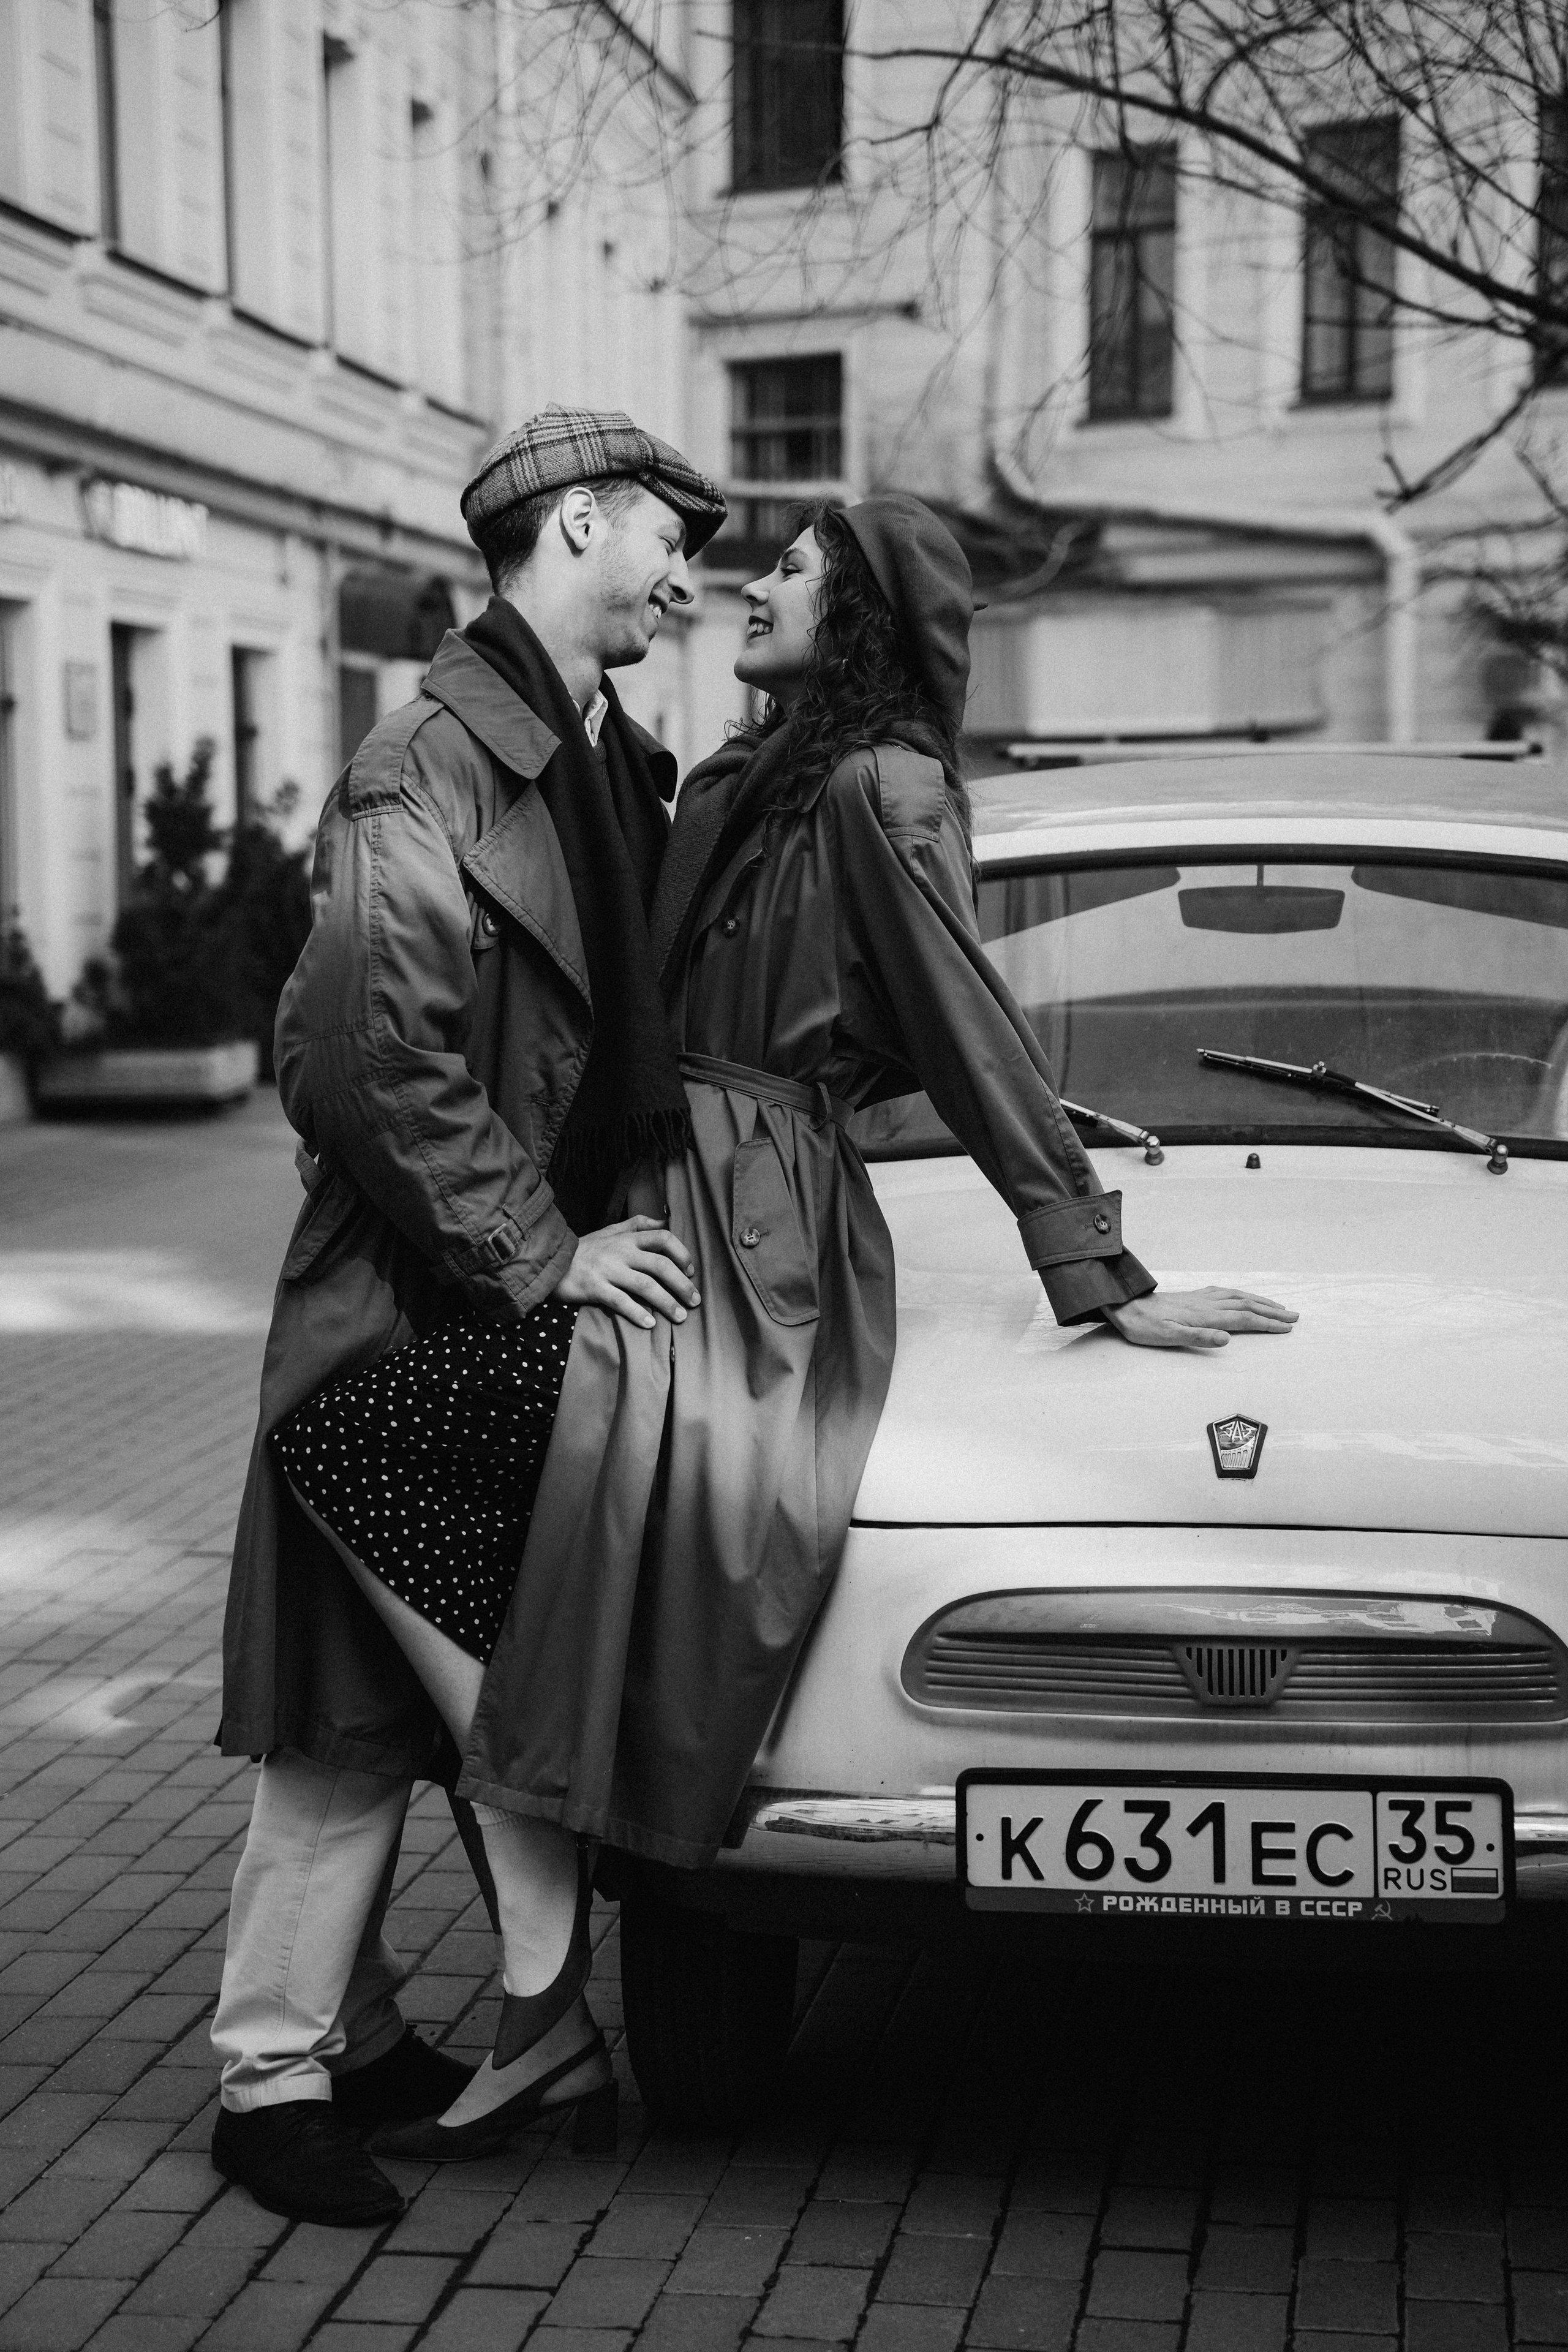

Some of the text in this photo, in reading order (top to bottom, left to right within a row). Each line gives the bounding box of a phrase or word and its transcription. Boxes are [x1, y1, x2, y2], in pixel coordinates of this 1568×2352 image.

[1389, 1800, 1476, 1866] 35
[1384, 1867, 1447, 1891] RUS
[1102, 1895, 1363, 1917] РОЖДЕННЫЙ В СССР
